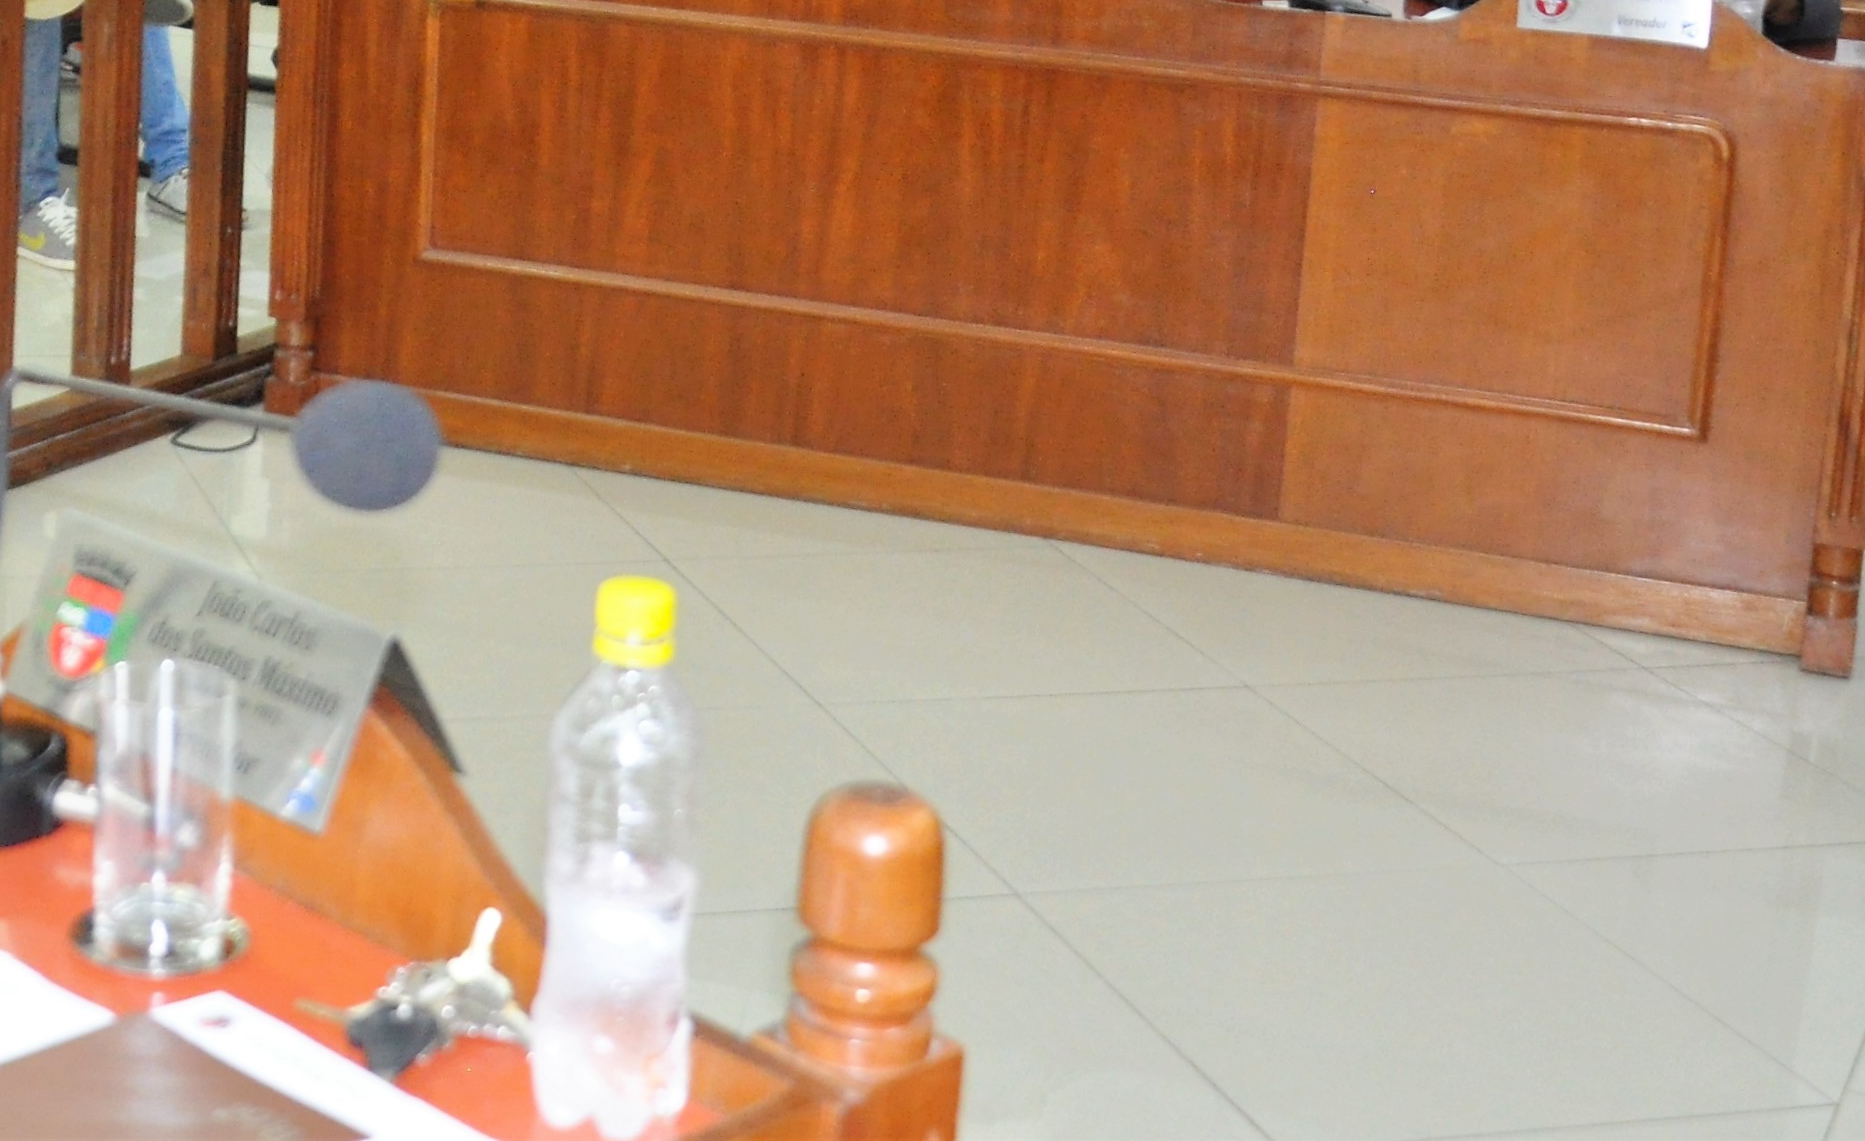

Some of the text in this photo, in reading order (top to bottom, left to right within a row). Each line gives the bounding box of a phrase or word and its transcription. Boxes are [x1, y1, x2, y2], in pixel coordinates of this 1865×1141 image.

[1617, 15, 1668, 29] Vereador
[196, 580, 317, 651] João Carlos
[148, 618, 184, 654] dos
[189, 628, 255, 681] Santos
